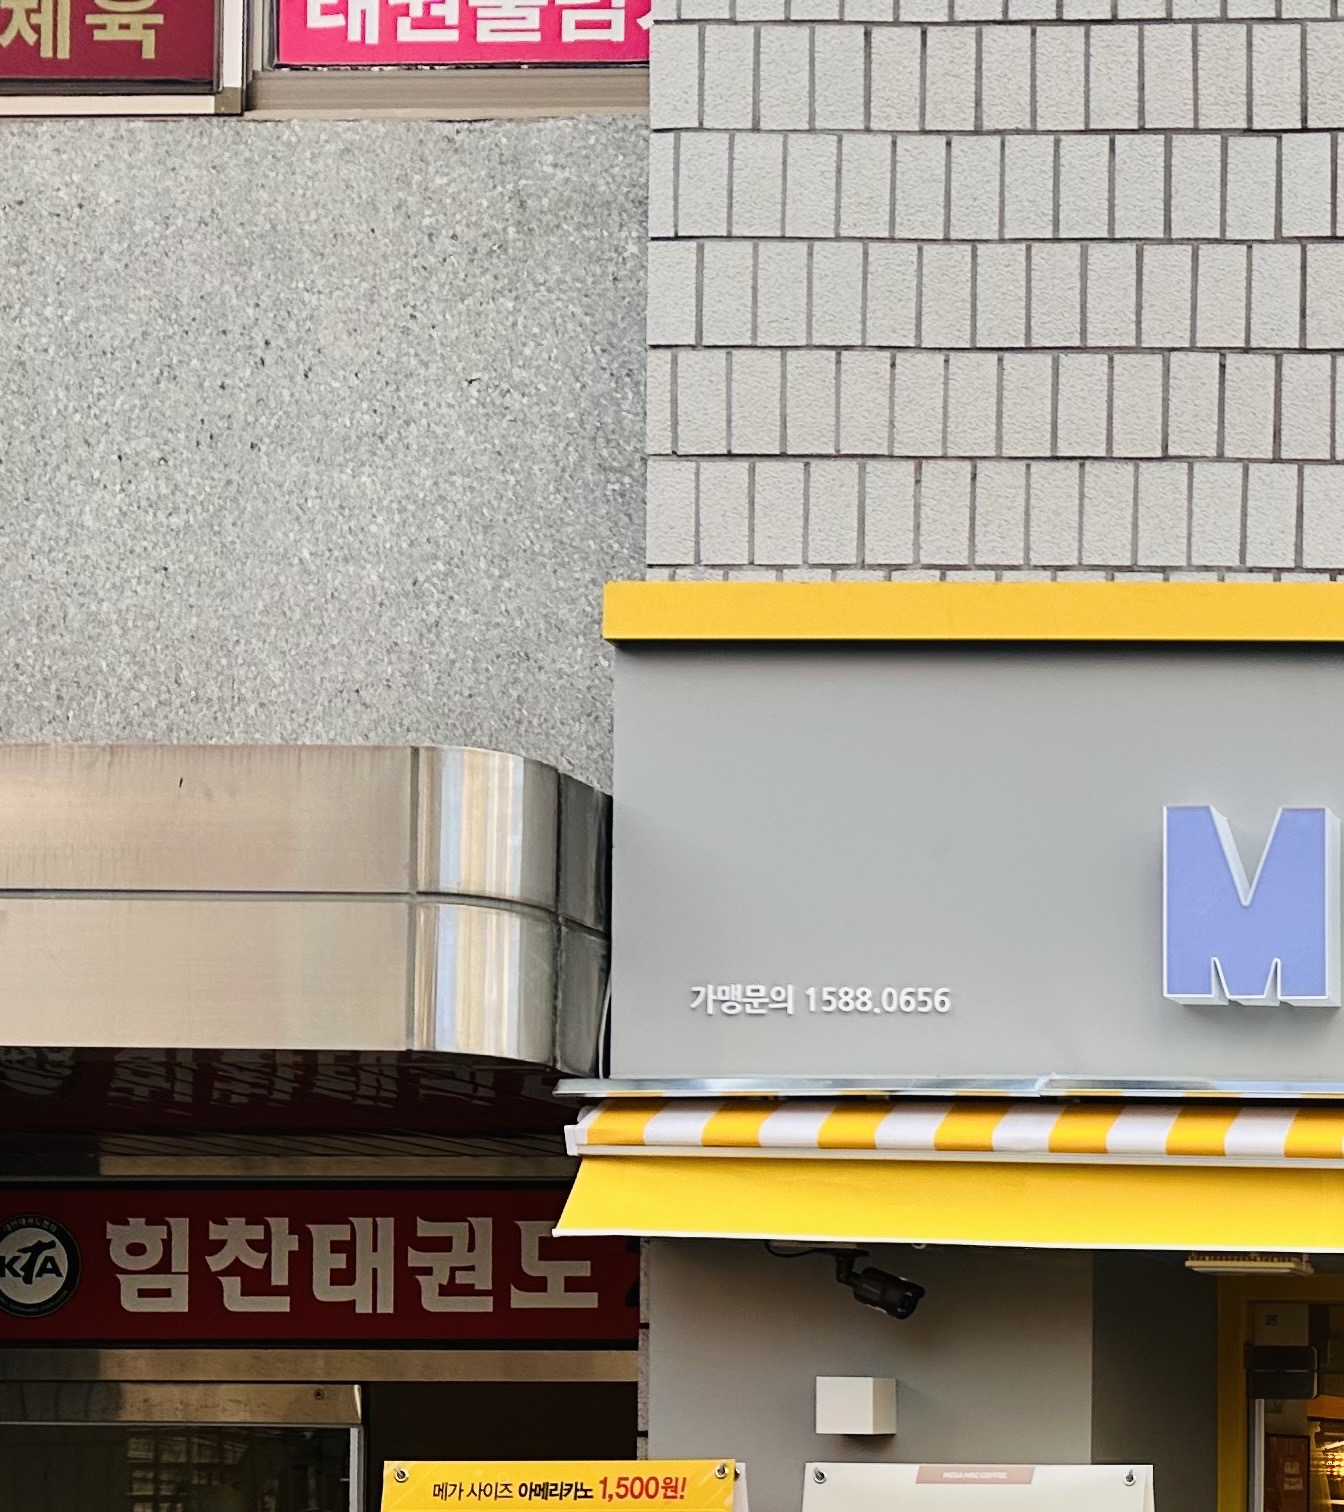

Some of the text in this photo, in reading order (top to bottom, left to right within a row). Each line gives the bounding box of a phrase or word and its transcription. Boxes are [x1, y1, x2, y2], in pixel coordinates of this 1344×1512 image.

[689, 984, 951, 1015] 가맹문의 1588.0656
[0, 1239, 63, 1285] KTA
[105, 1215, 600, 1315] 힘찬태권도
[431, 1476, 688, 1502] 메가 사이즈 아메리카노 1,500원!
